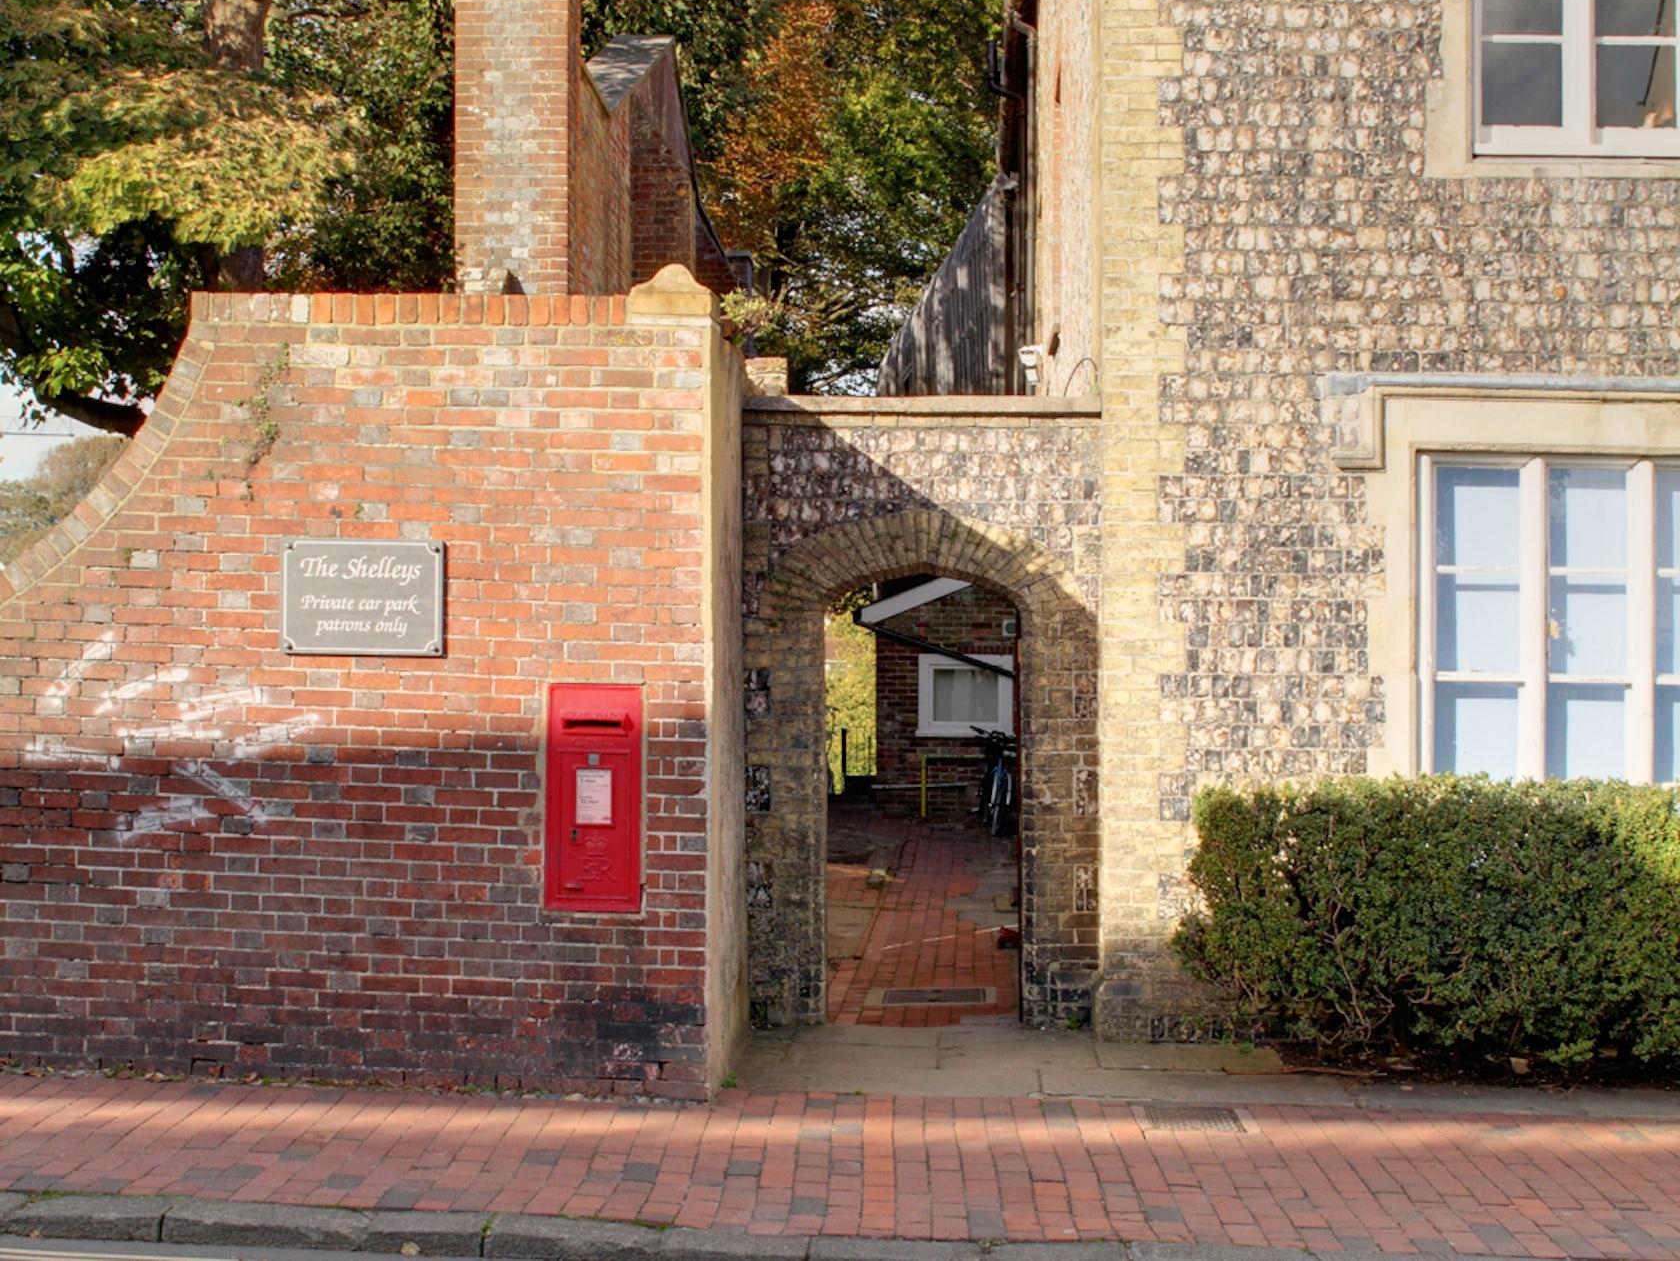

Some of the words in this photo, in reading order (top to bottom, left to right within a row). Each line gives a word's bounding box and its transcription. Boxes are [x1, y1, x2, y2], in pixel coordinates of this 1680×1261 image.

[300, 555, 338, 578] The
[342, 556, 422, 585] Shelleys
[300, 594, 355, 611] Private
[358, 598, 382, 611] car
[383, 595, 421, 616] park
[315, 618, 371, 636] patrons
[375, 616, 408, 638] only
